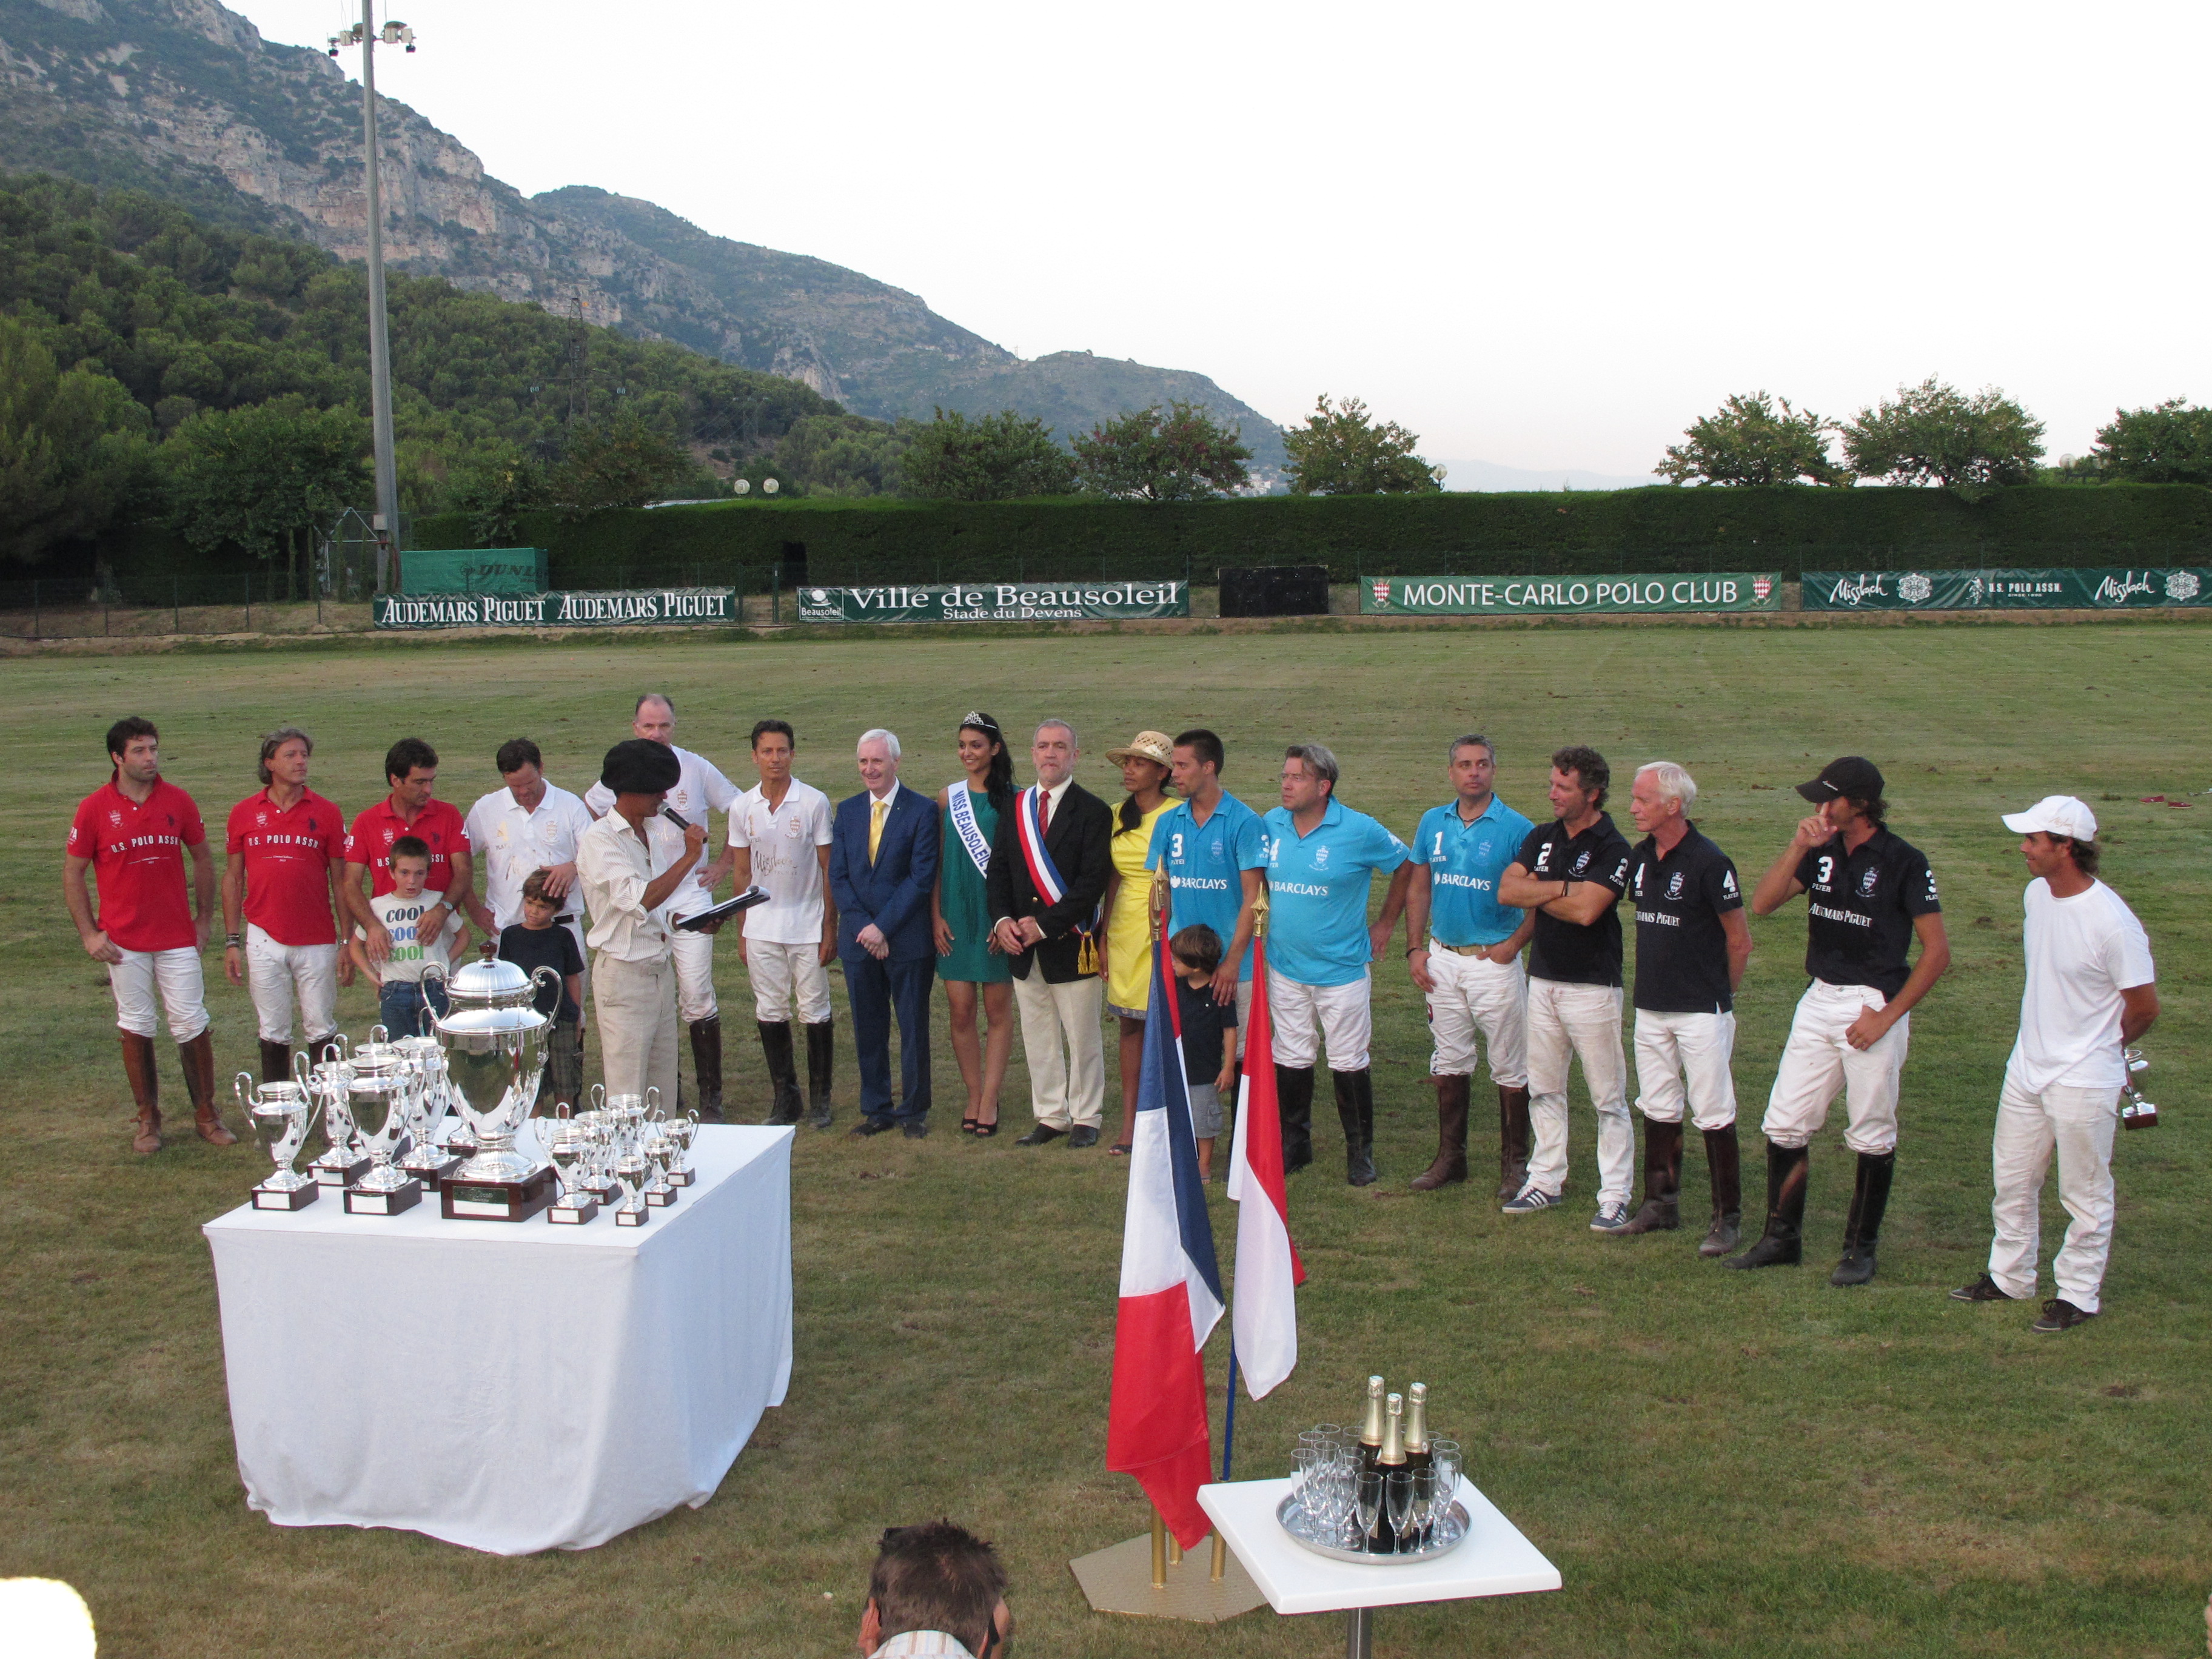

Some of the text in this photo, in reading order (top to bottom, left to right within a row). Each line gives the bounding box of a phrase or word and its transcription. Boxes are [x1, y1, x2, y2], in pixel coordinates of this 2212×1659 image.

[848, 582, 1179, 609] Ville de Beausoleil
[1403, 581, 1737, 606] MONTE-CARLO POLO CLUB
[1989, 583, 2062, 592] U.S. POLO ASSN.
[381, 597, 546, 623] AUDEMARS PIGUET
[557, 592, 727, 620] AUDEMARS PIGUET
[801, 607, 842, 616] Beausoleil
[942, 606, 1082, 620] Stade du Devens
[267, 834, 290, 844] POLO
[951, 789, 990, 868] MISS BEAUSOLEIL
[110, 842, 128, 853] U.S.
[131, 835, 154, 848] POLO
[1171, 833, 1183, 857] 3
[1433, 831, 1443, 856] 1
[1537, 843, 1552, 866] 2
[1614, 857, 1629, 880] 2
[1635, 863, 1645, 889] 4
[1817, 856, 1833, 883] 3
[1181, 877, 1228, 890] BARCLAYS
[1274, 881, 1329, 896] BARCLAYS
[1441, 873, 1491, 891] BARCLAYS
[1723, 870, 1736, 893] 4
[1925, 870, 1936, 893] 3
[1844, 910, 1872, 928] PIGUET
